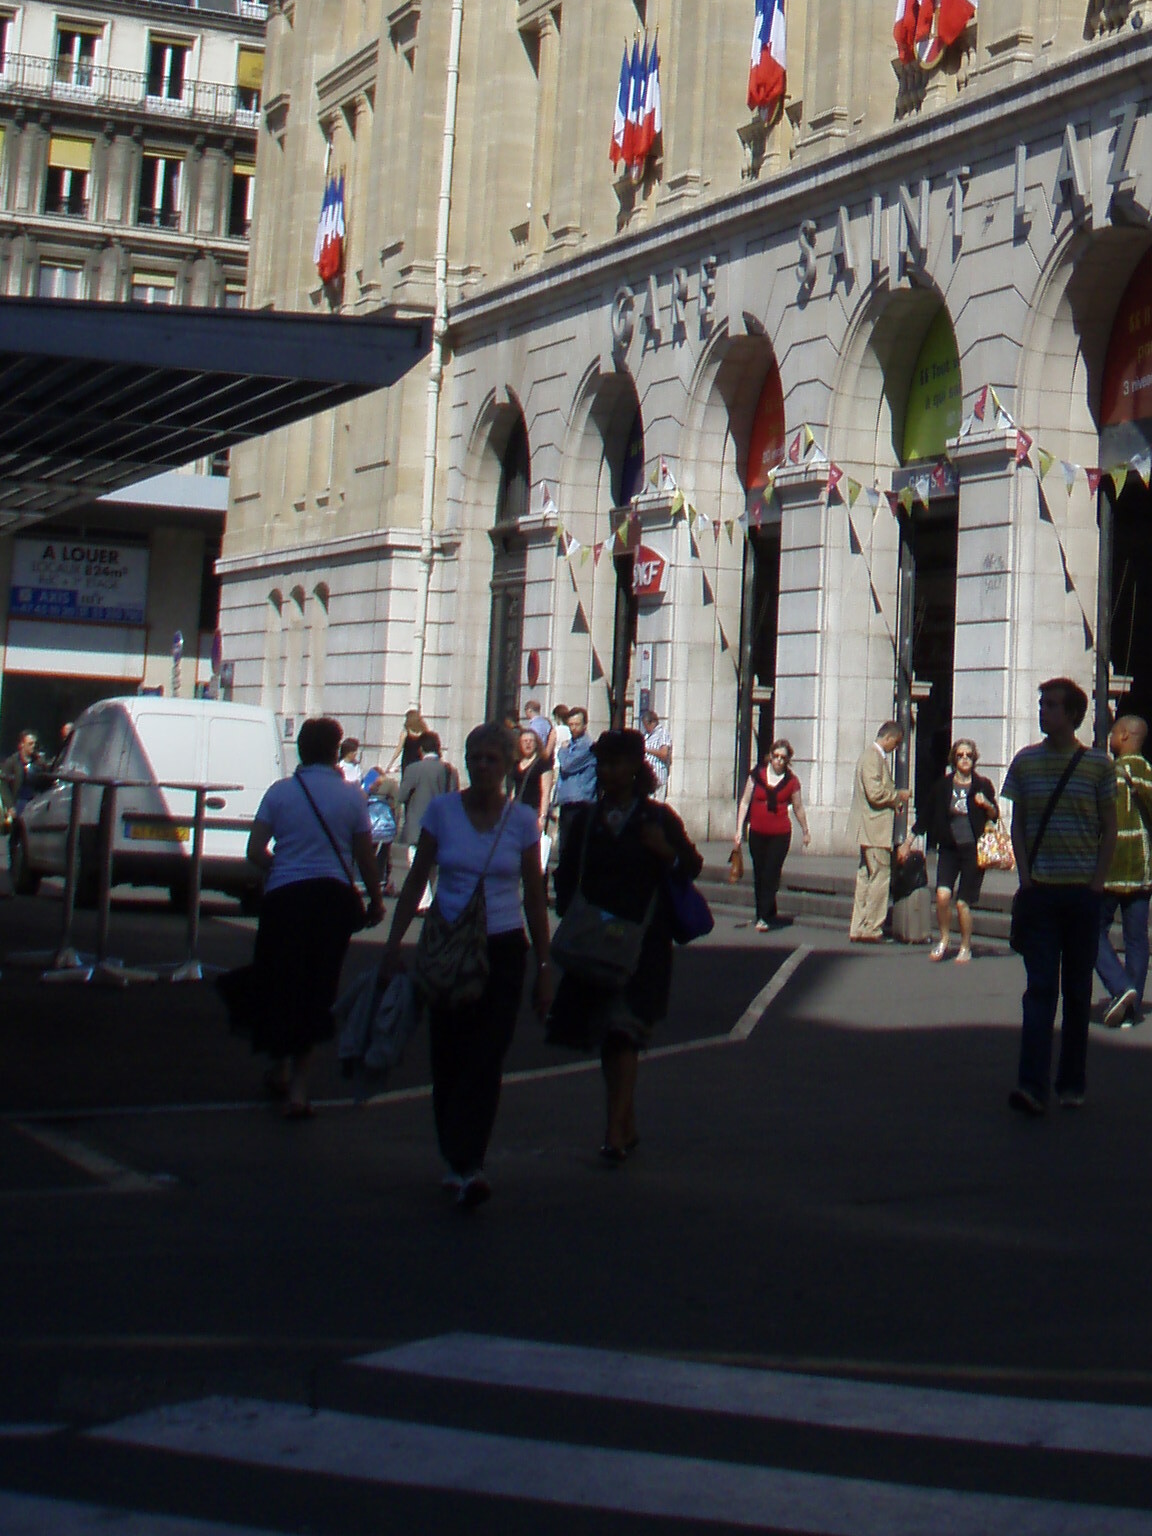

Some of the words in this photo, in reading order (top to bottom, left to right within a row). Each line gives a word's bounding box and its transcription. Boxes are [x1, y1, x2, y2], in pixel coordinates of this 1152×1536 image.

[611, 256, 717, 340] GARE
[1123, 379, 1130, 396] 3
[43, 545, 56, 560] A
[63, 546, 119, 564] LOUER
